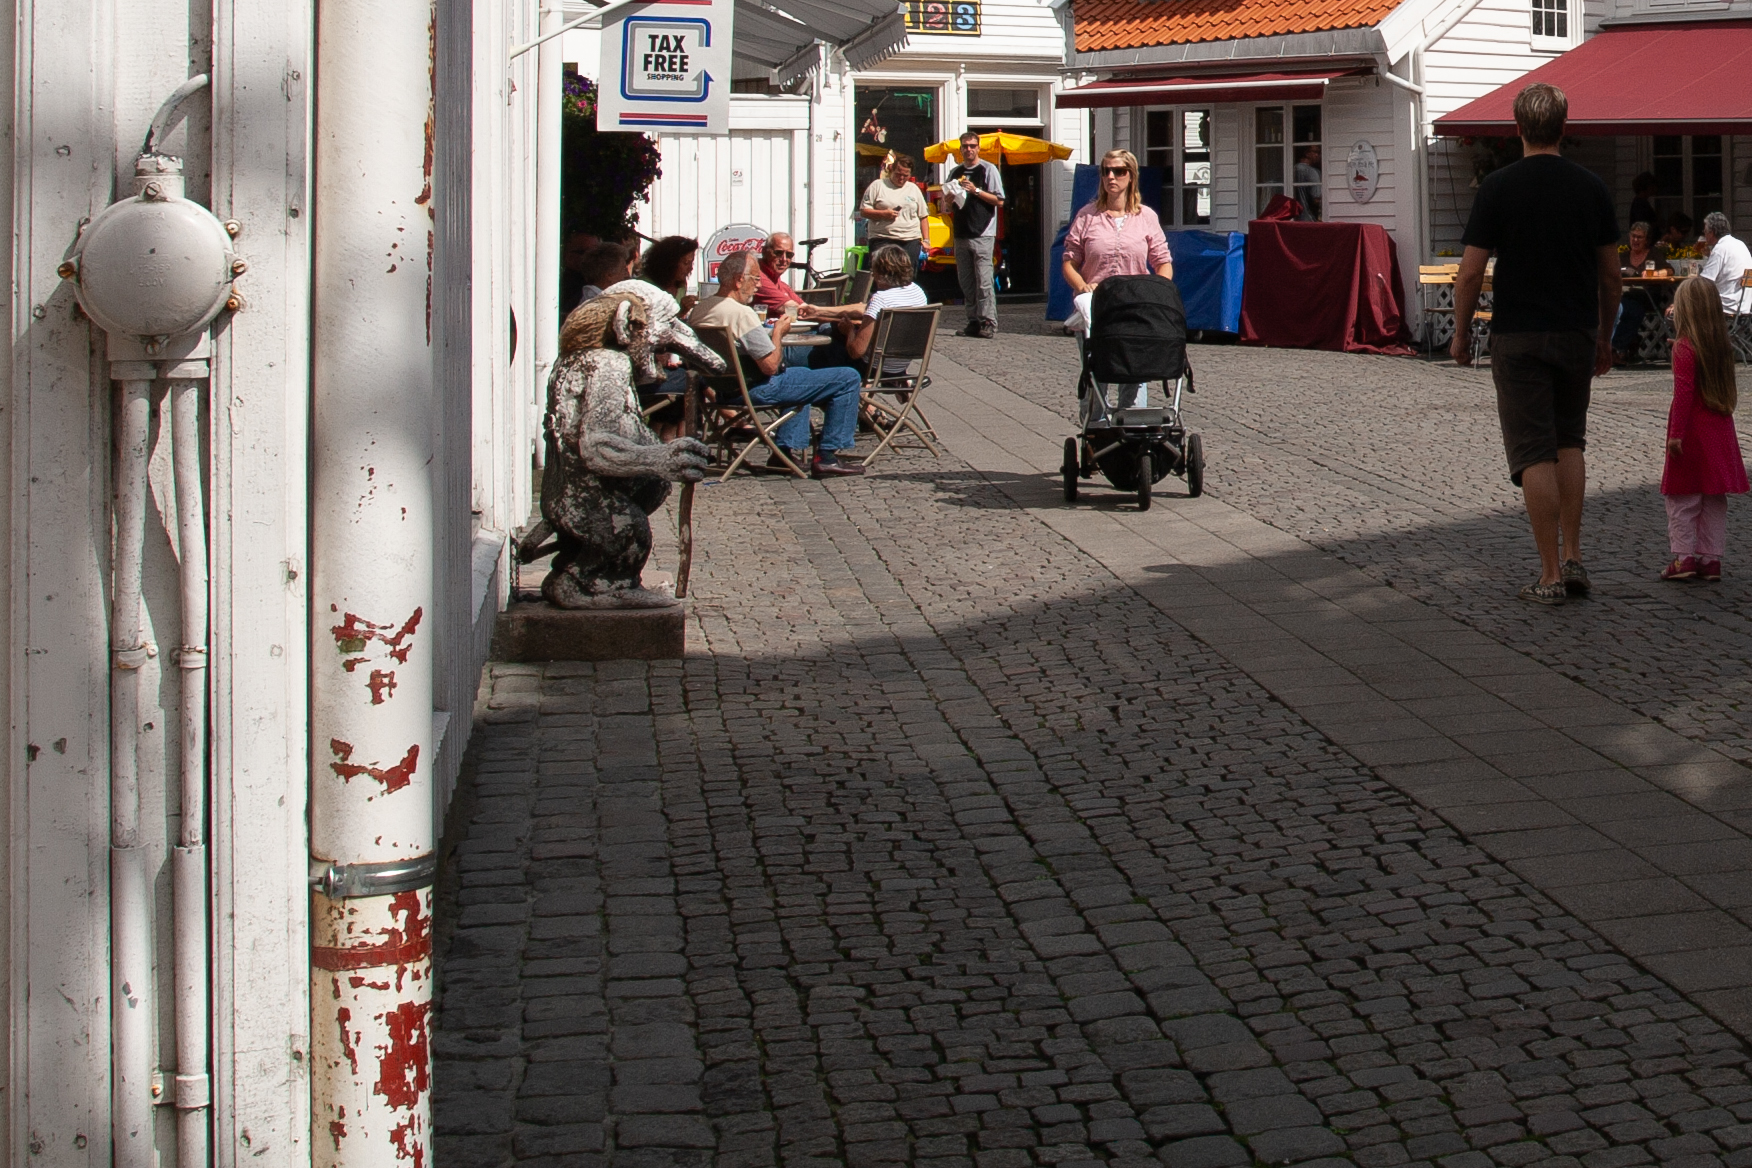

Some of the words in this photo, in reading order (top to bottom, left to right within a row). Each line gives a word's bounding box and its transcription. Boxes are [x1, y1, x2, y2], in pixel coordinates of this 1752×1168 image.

[648, 34, 686, 54] TAX
[643, 53, 690, 73] FREE
[646, 73, 685, 82] SHOPPING
